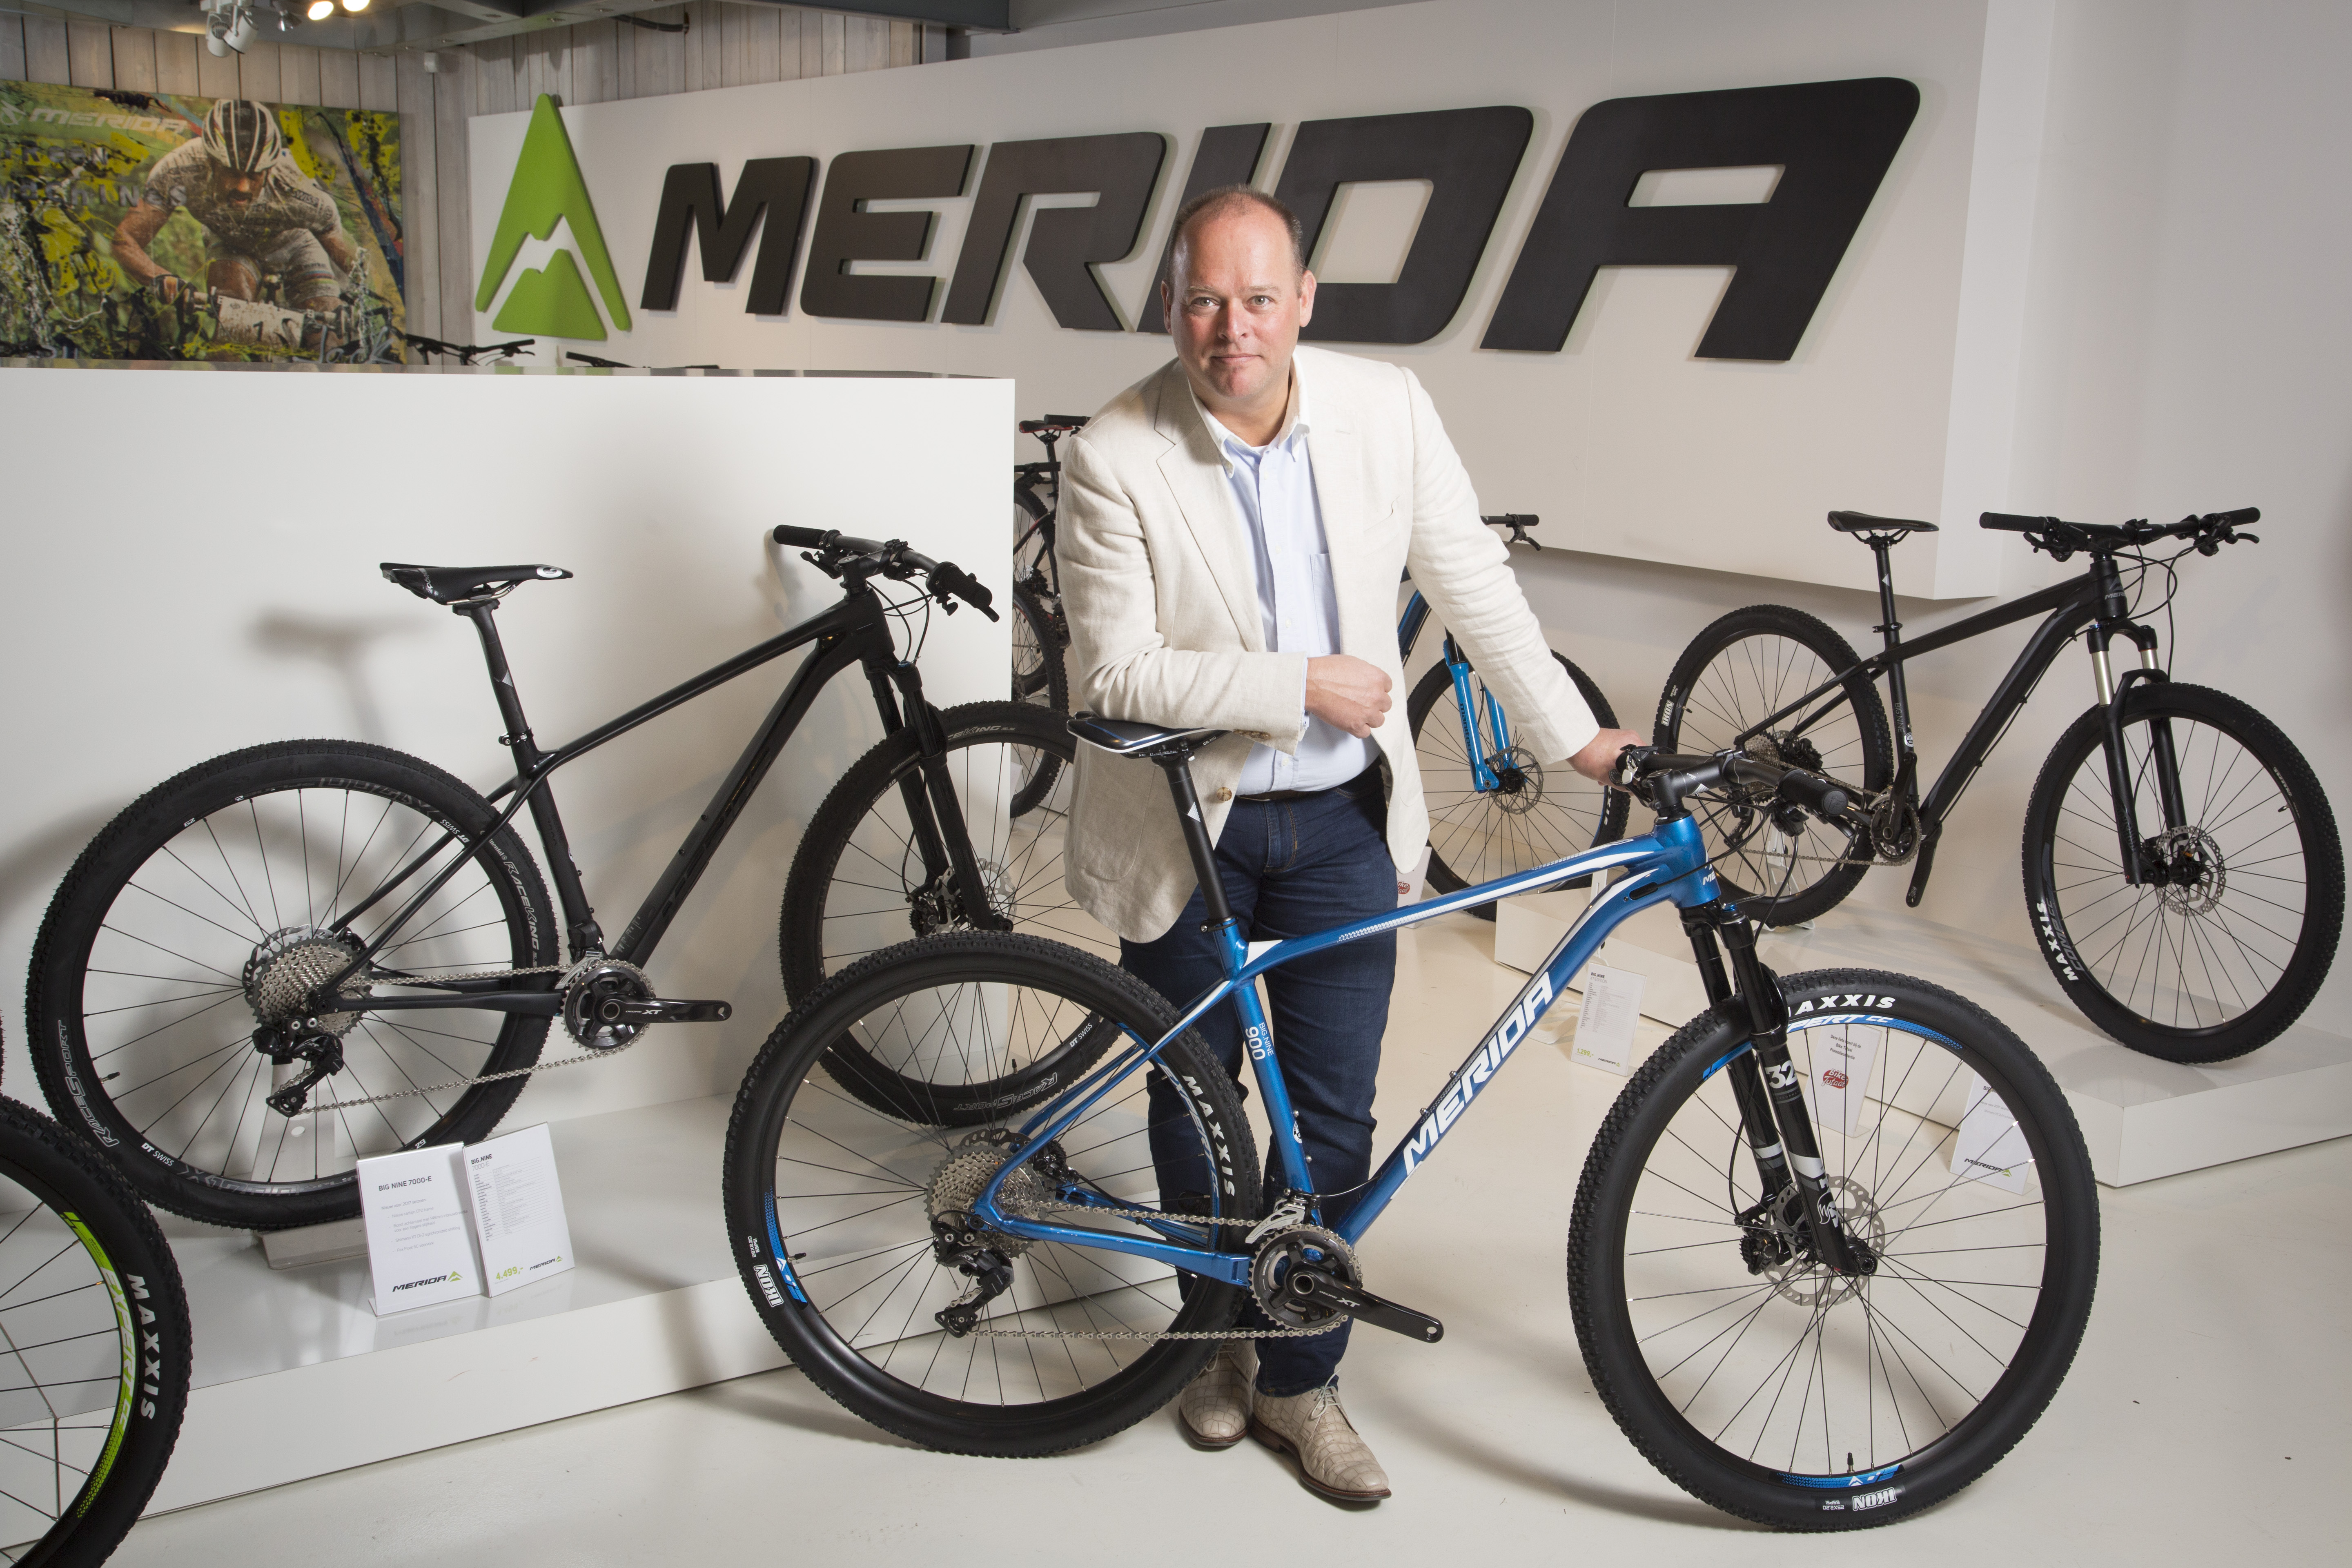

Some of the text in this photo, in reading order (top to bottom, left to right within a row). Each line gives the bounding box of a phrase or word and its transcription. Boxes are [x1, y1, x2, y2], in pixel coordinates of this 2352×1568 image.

[29, 107, 188, 134] MERIDA
[641, 77, 1921, 361] MERIDA
[1661, 699, 1674, 726] IKON
[872, 778, 896, 804] DT SWISS
[440, 819, 470, 844] DT SWISS
[2037, 902, 2079, 981] MAXXIS
[2046, 898, 2085, 971] COMP CC
[1069, 1022, 1093, 1048] DT SWISS
[1787, 1014, 1865, 1033] PERT
[1245, 1026, 1266, 1060] 900
[1259, 1022, 1274, 1057] BIG.NINE
[1577, 1048, 1594, 1058] 1.299,-
[1403, 971, 1553, 1176] MERIDA
[1764, 1060, 1797, 1089] 32
[1829, 1068, 1846, 1080] Bike
[1158, 1063, 1219, 1198] EXPERT CC
[1182, 1075, 1235, 1196] MAXXIS
[141, 1142, 174, 1167] DT SWISS
[471, 1154, 493, 1165] BIG.NINE
[472, 1161, 490, 1171] 7000-E
[1964, 1158, 2003, 1172] MERIDA
[391, 1180, 407, 1189] NINE
[408, 1176, 432, 1186] 7000-E
[495, 1266, 524, 1281] 4.499,-
[530, 1258, 556, 1271] MERIDA
[392, 1274, 447, 1292] MERIDA
[753, 1264, 784, 1307] IKON
[1319, 1290, 1361, 1308] DEORE XT
[100, 1266, 136, 1431] EXPERT CC
[127, 1273, 160, 1420] MAXXIS
[1852, 1487, 1897, 1511] IKON
